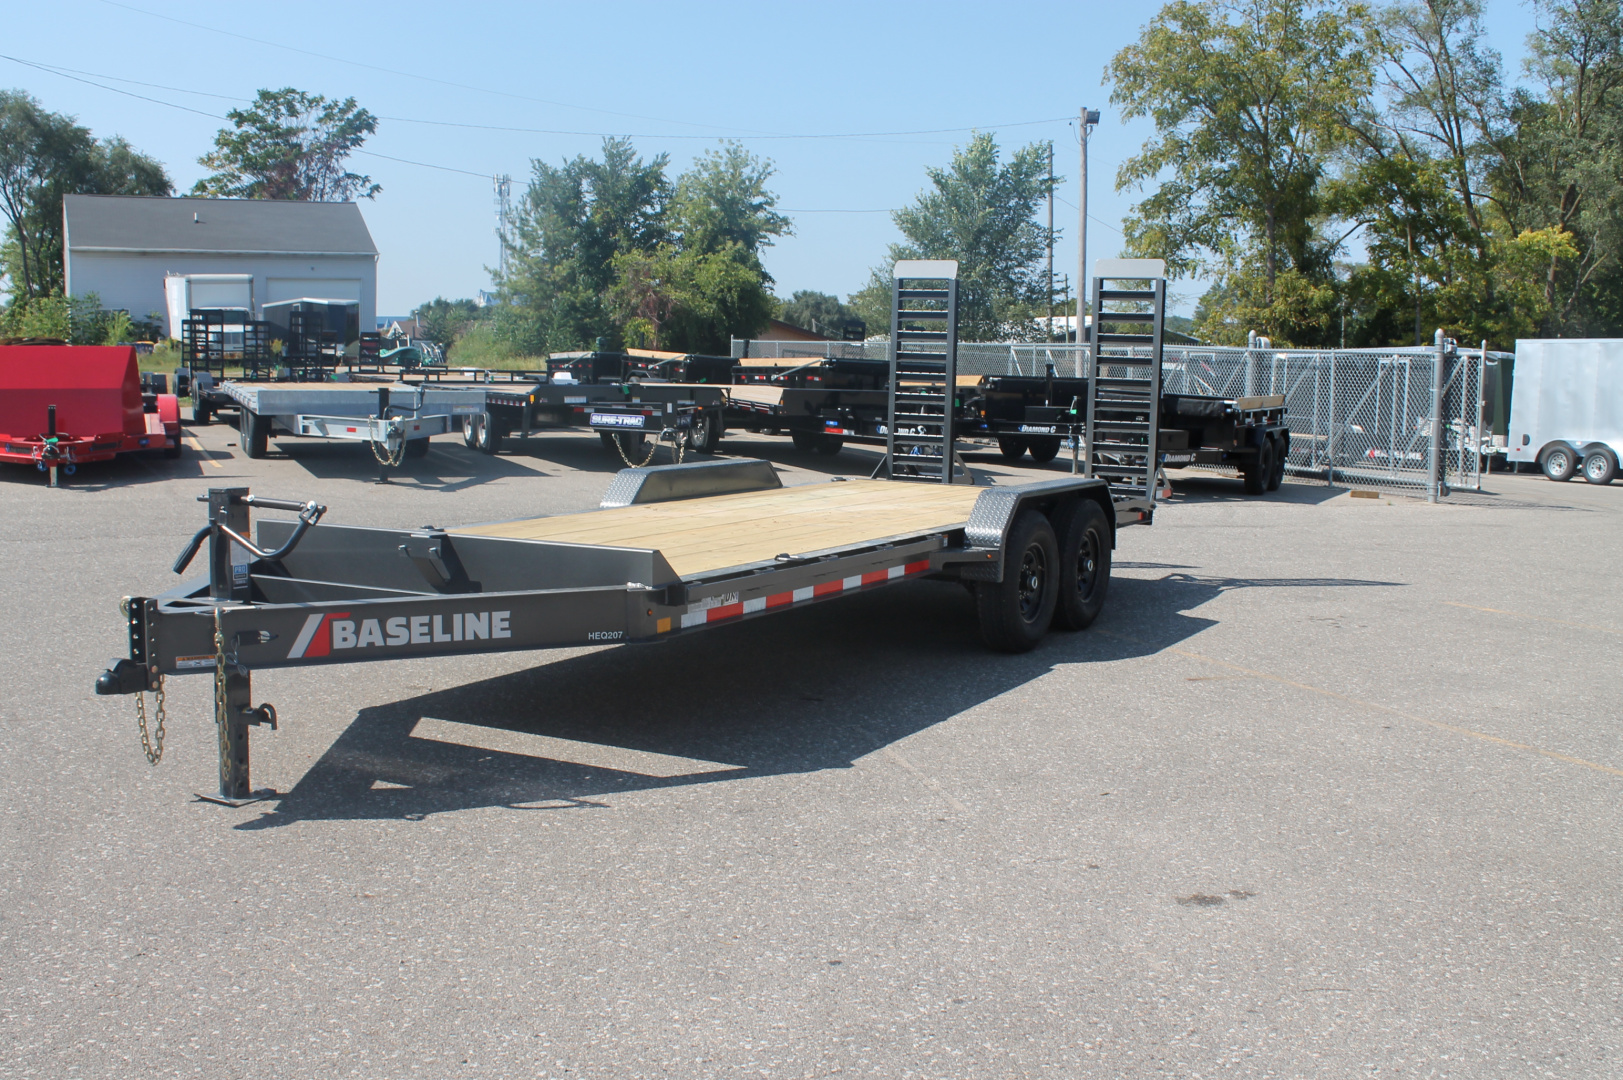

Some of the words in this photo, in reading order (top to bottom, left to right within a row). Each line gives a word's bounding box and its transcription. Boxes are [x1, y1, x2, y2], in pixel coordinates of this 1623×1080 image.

[592, 415, 643, 426] SURE-TRAC
[1022, 425, 1050, 433] DIAMOND
[1165, 453, 1190, 462] DIAMOND
[1190, 453, 1196, 462] C
[332, 610, 512, 649] BASELINE
[588, 631, 623, 640] HEQ207
